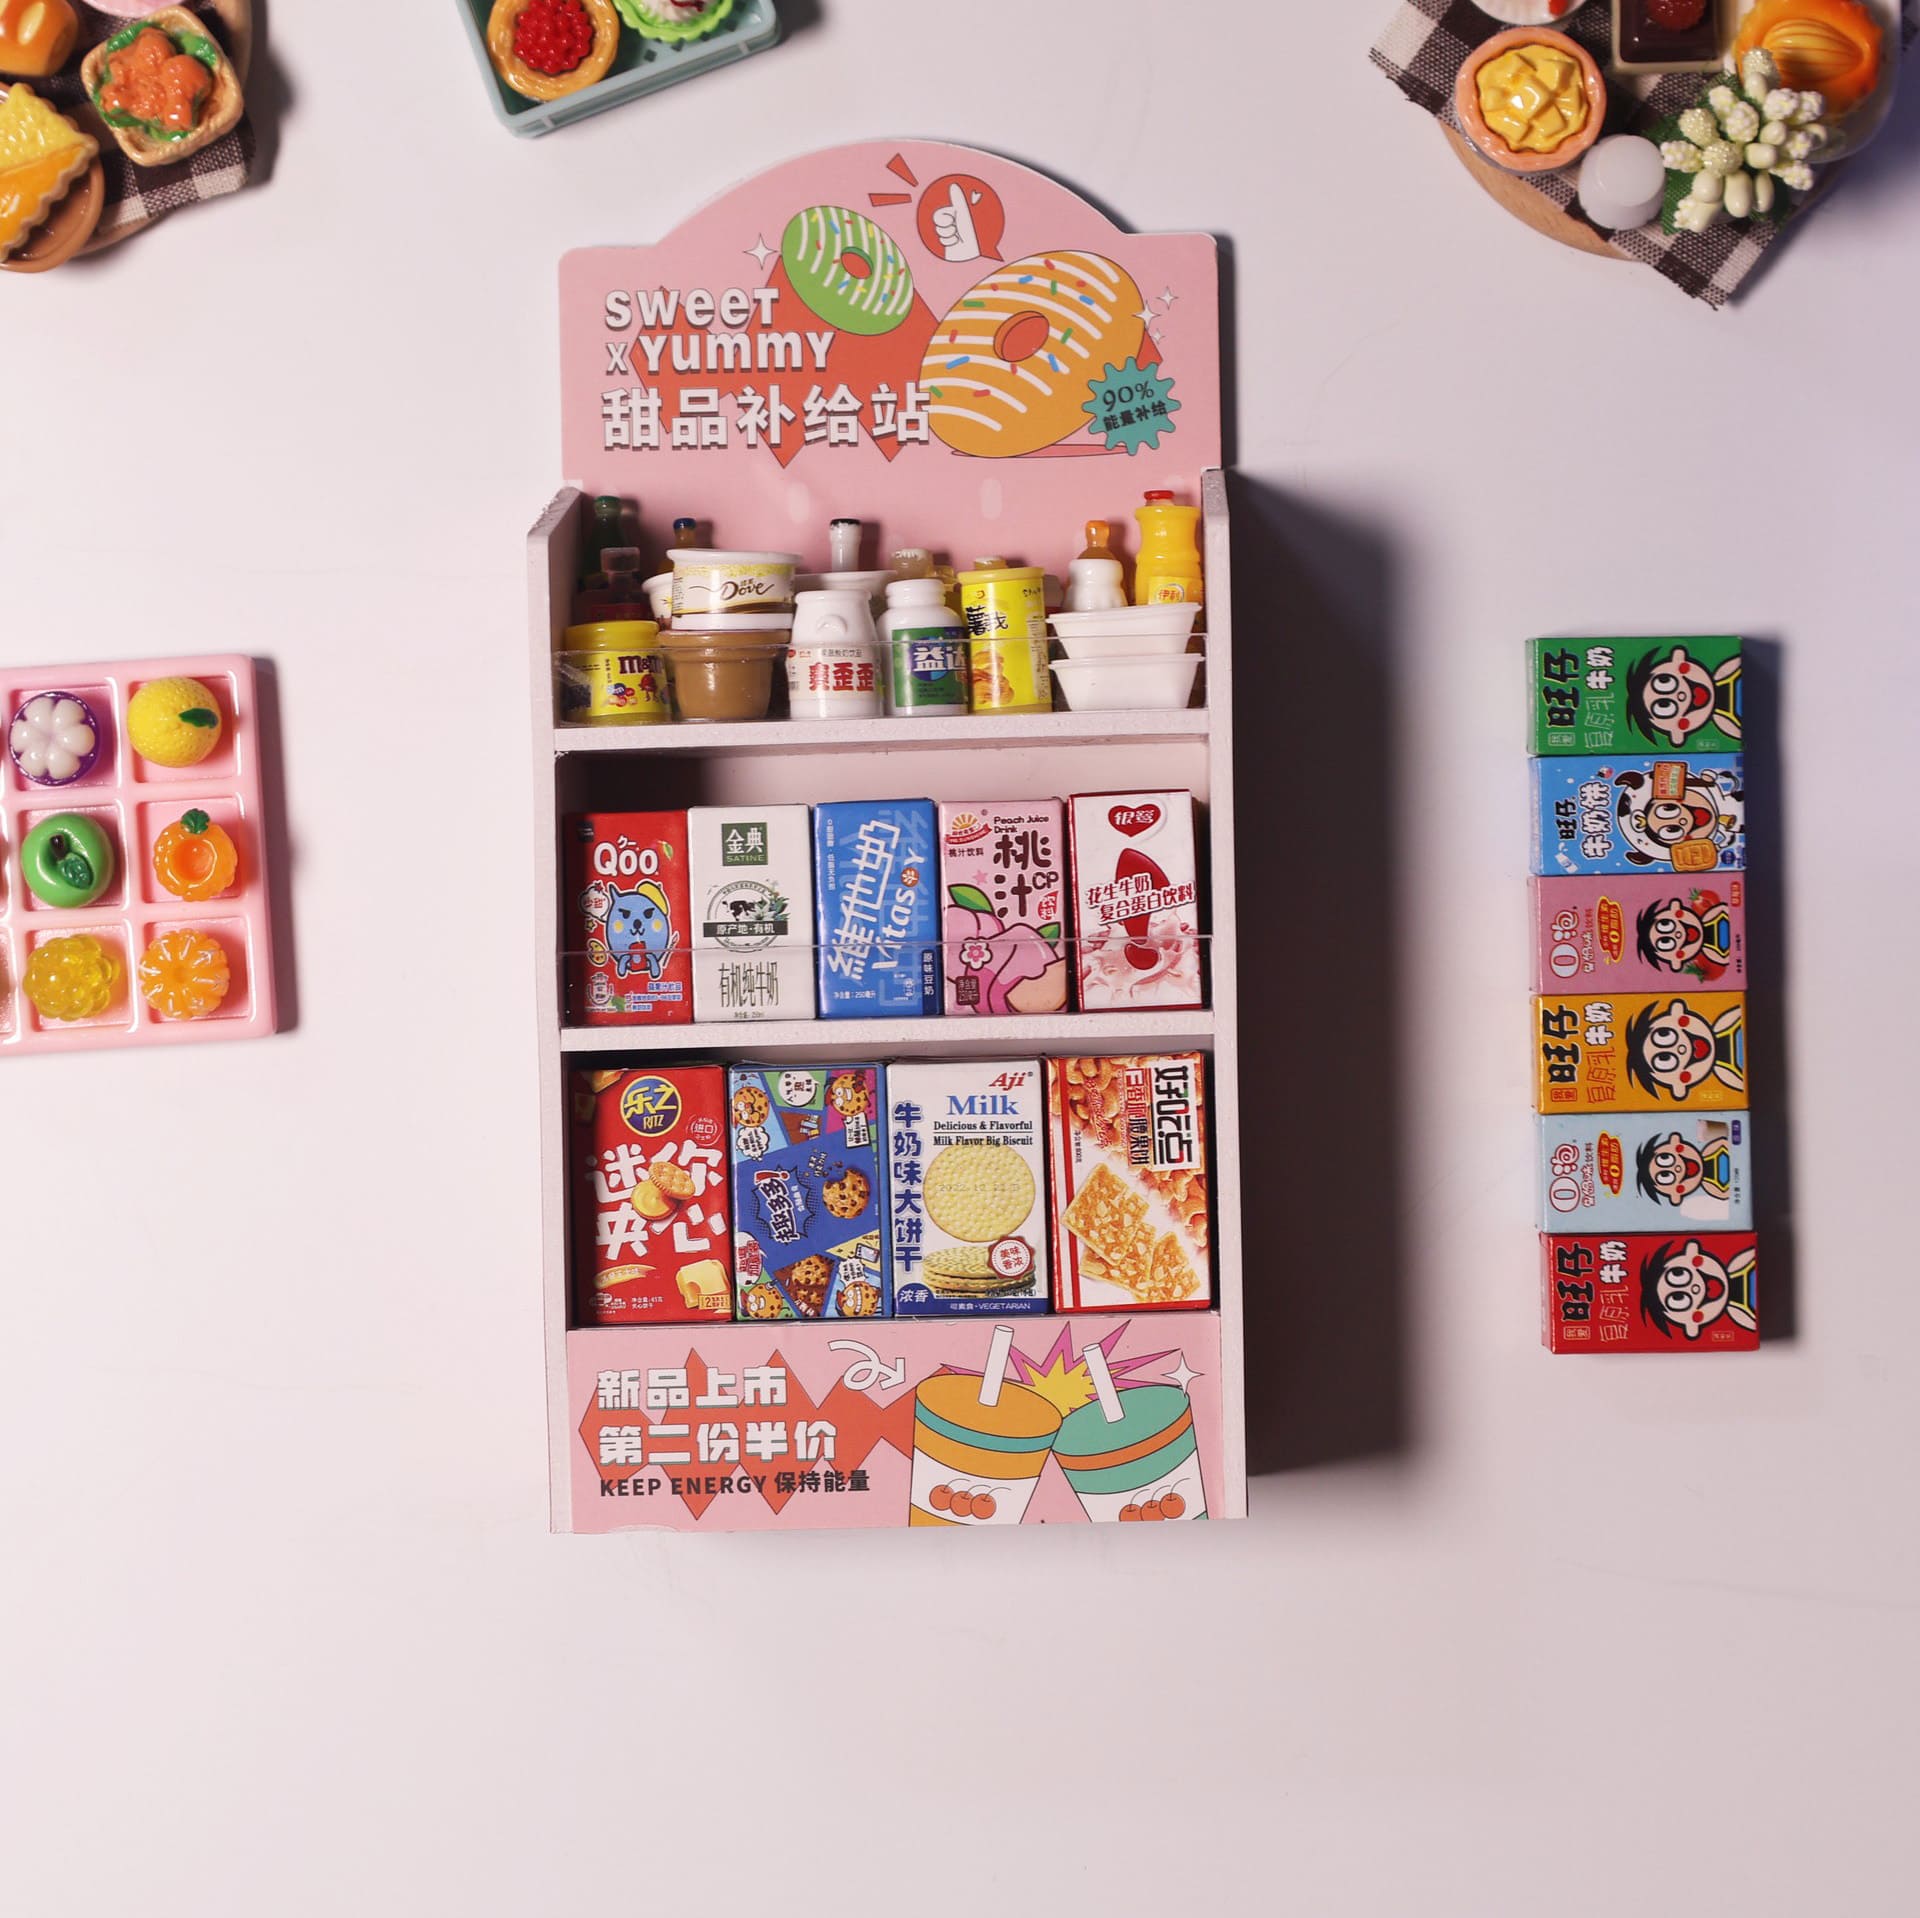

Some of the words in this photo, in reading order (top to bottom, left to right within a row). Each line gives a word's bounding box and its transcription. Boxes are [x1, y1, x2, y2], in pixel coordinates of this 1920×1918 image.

[601, 382, 932, 450] 甜品补给站
[1102, 381, 1155, 412] 90%
[1102, 400, 1168, 432] 能量补给
[720, 580, 775, 600] Dove
[1543, 648, 1579, 727] 旺仔
[1585, 646, 1614, 690] 牛奶
[994, 816, 1025, 825] Peach
[1027, 815, 1049, 823] Juice
[994, 825, 1017, 834] Drink
[1555, 799, 1577, 840] 旺仔
[1579, 782, 1612, 859] 牛奶饼
[725, 828, 765, 854] 金典
[726, 854, 765, 863] SATINE
[827, 819, 900, 980] 維他奶
[1033, 871, 1059, 889] CP
[1087, 874, 1151, 906] 花生牛奶
[1100, 883, 1194, 922] 复合蛋白饮料
[718, 961, 780, 1008] 有机纯牛奶
[923, 952, 935, 996] 原味豆奶
[1583, 1002, 1614, 1046] 牛奶
[1543, 1005, 1580, 1084] 旺仔
[989, 1072, 1027, 1091] Aji
[623, 1085, 678, 1119] 乐之
[946, 1095, 1020, 1116] Milk
[1155, 1066, 1193, 1164] 好吃点
[643, 1115, 664, 1130] RITZ
[933, 1136, 953, 1145] Milk
[955, 1136, 984, 1145] Flavor
[986, 1136, 1001, 1147] Big
[1002, 1136, 1033, 1145] Biscuit
[934, 1121, 977, 1130] Delicious
[979, 1121, 987, 1130] &
[989, 1120, 1033, 1130] Flavorful
[586, 1139, 723, 1204] 迷你
[893, 1102, 923, 1272] 牛奶味大饼干
[596, 1202, 727, 1261] 夹心
[1557, 1242, 1594, 1322] 旺仔
[1599, 1240, 1628, 1284] 牛奶
[899, 1289, 929, 1303] 浓香
[598, 1366, 788, 1410] 新品上市
[598, 1420, 838, 1465] 第二份半价
[600, 1477, 661, 1497] KEEP
[671, 1475, 768, 1495] ENERGY
[775, 1468, 870, 1493] 保持能量
